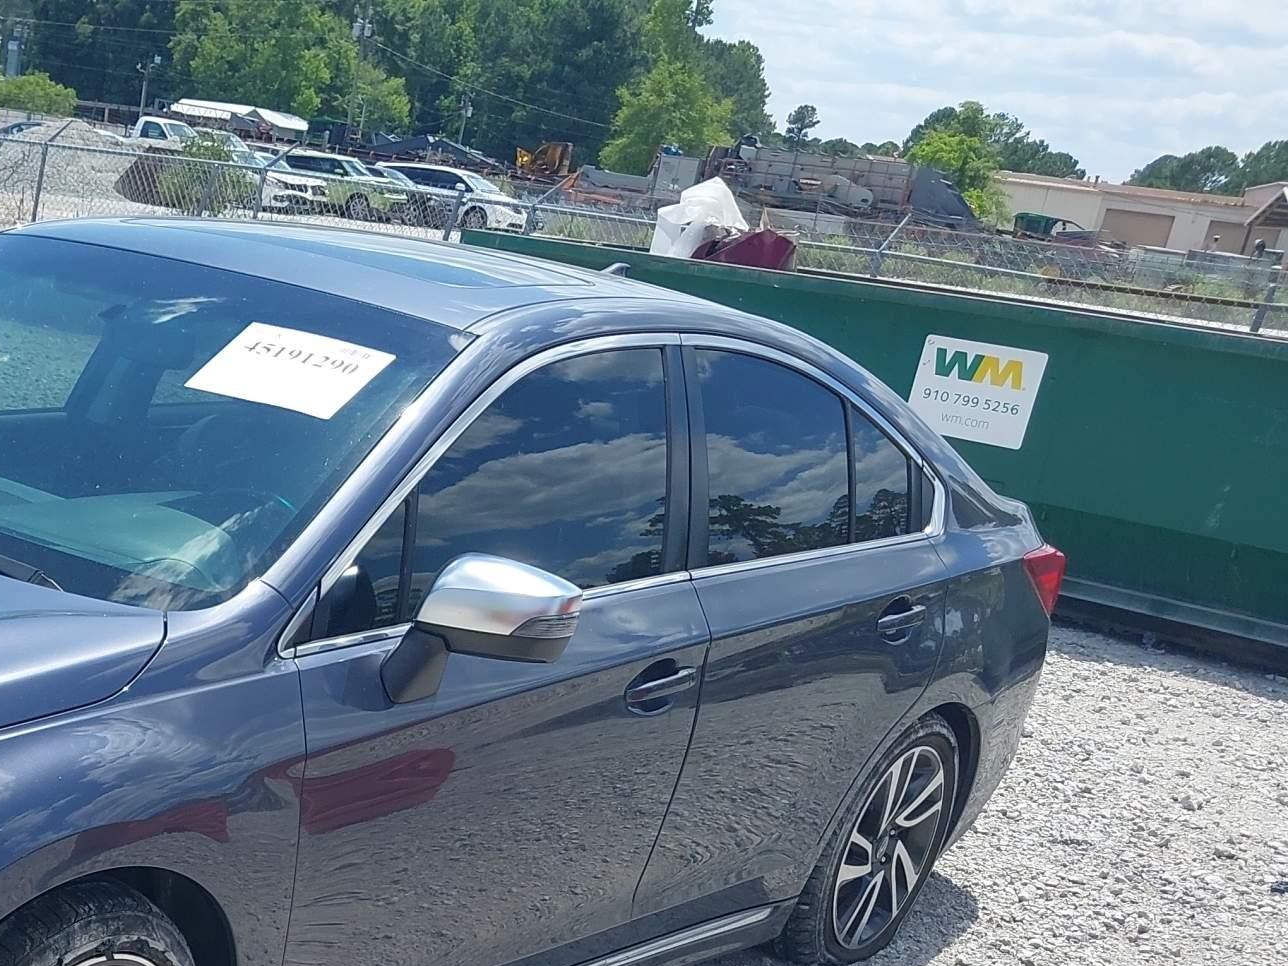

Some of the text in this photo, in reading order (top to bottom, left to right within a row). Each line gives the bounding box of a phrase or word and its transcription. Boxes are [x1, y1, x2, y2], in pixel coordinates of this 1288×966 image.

[244, 341, 359, 375] 45191290
[935, 348, 1024, 391] WM
[922, 388, 1020, 415] 910 799 5256
[940, 412, 990, 430] wm.com
